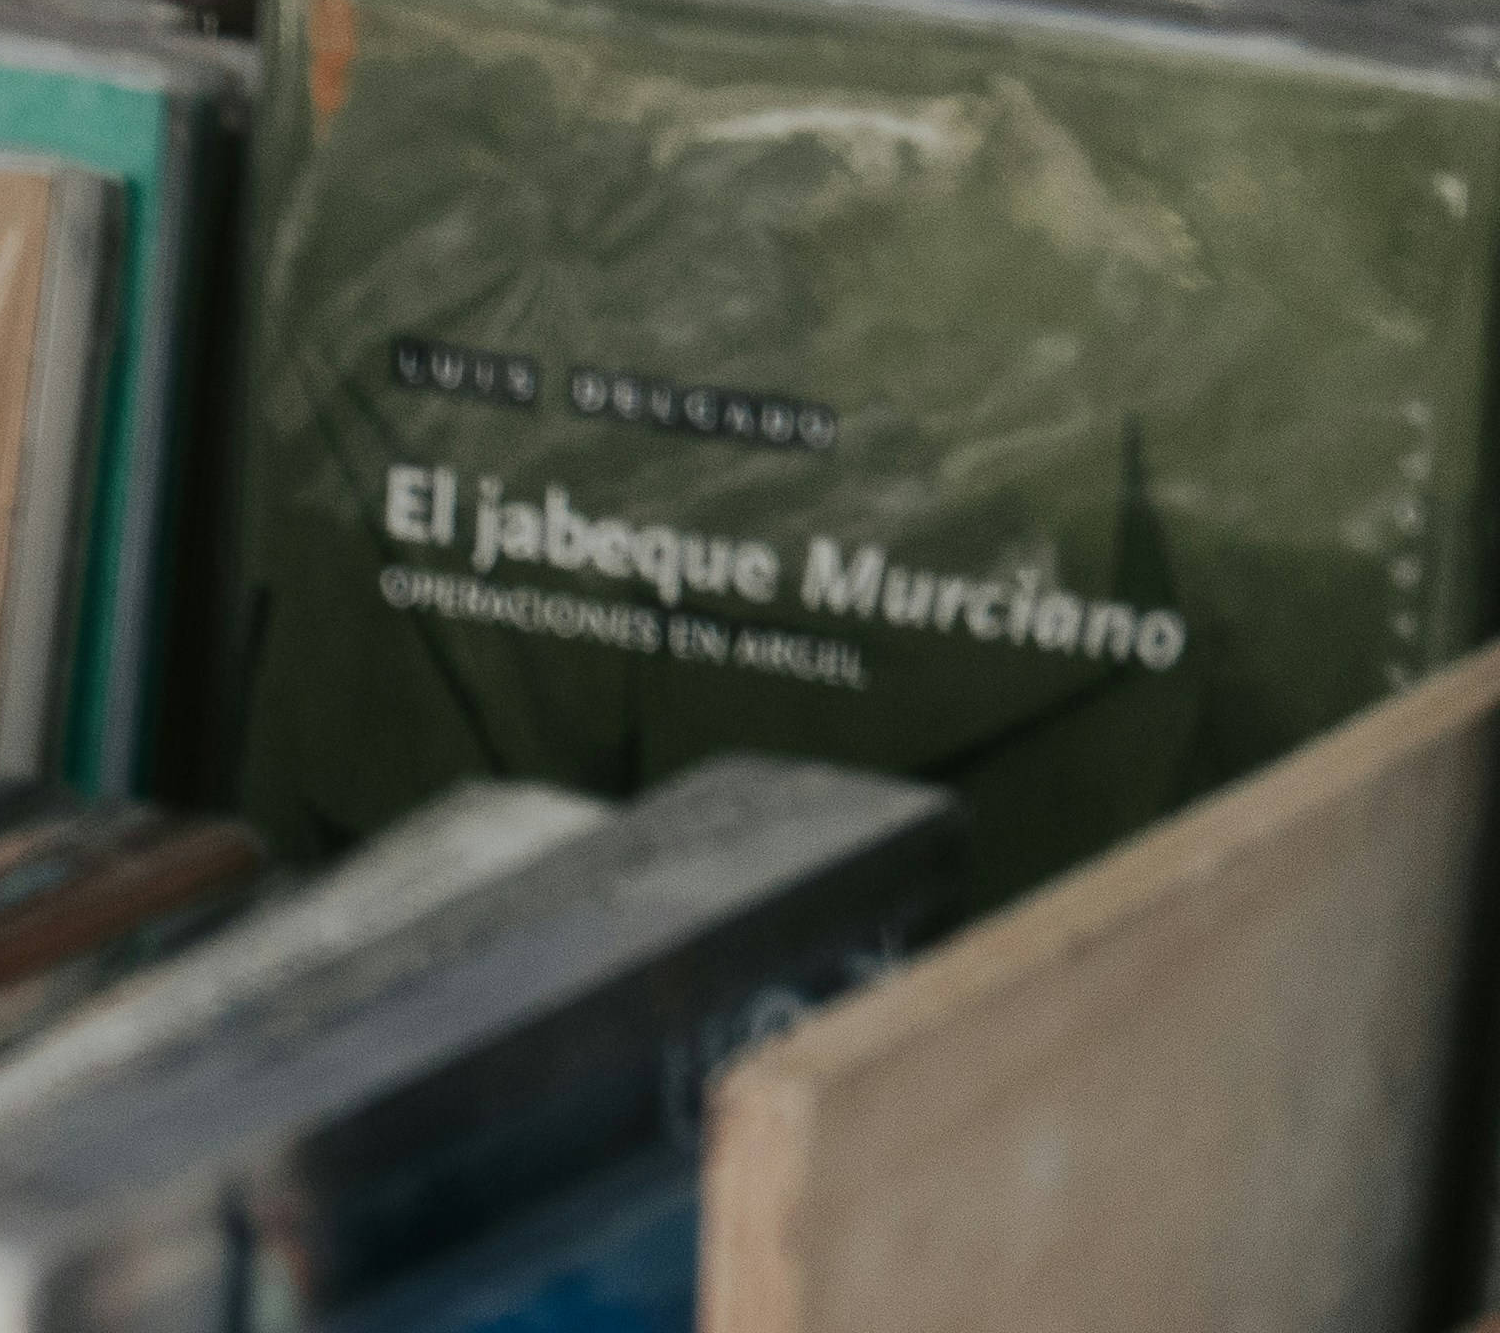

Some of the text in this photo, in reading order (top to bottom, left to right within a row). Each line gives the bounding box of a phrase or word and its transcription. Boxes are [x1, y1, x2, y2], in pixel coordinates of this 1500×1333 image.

[383, 464, 1187, 672] El jabeque Murciano
